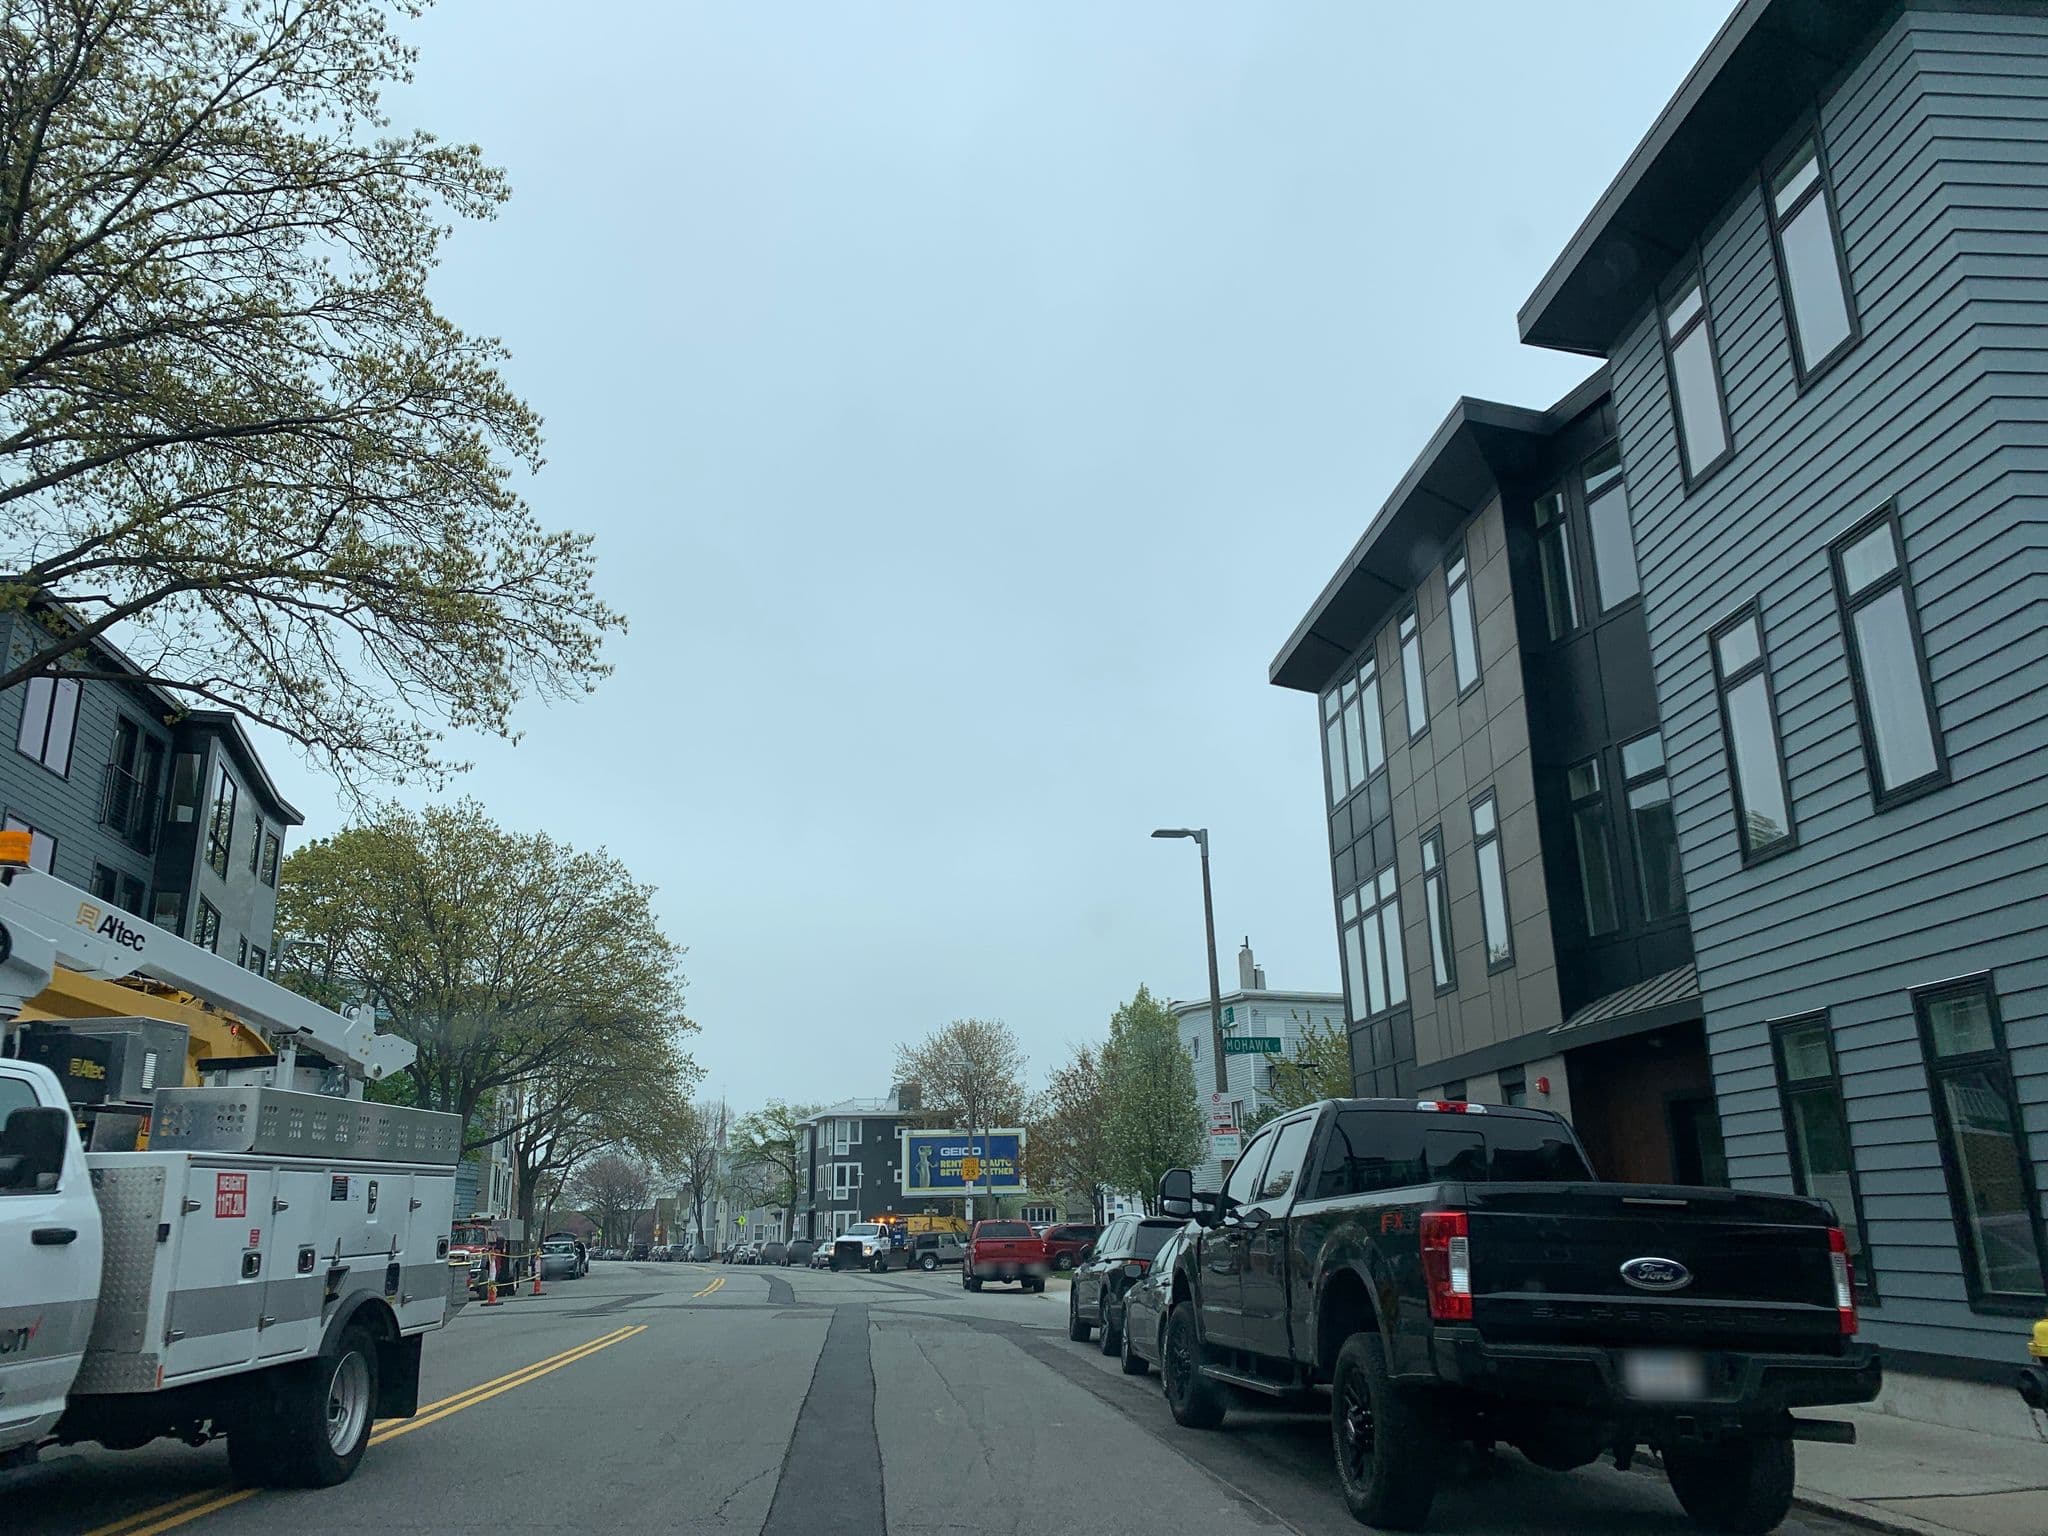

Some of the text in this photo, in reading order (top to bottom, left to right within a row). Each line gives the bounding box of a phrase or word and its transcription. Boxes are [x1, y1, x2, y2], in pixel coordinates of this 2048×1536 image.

[97, 914, 145, 951] Altec
[1226, 1039, 1270, 1051] MOHAWK
[940, 1147, 981, 1157] GEICO
[940, 1159, 964, 1169] RENT
[1638, 1262, 1673, 1280] Ford
